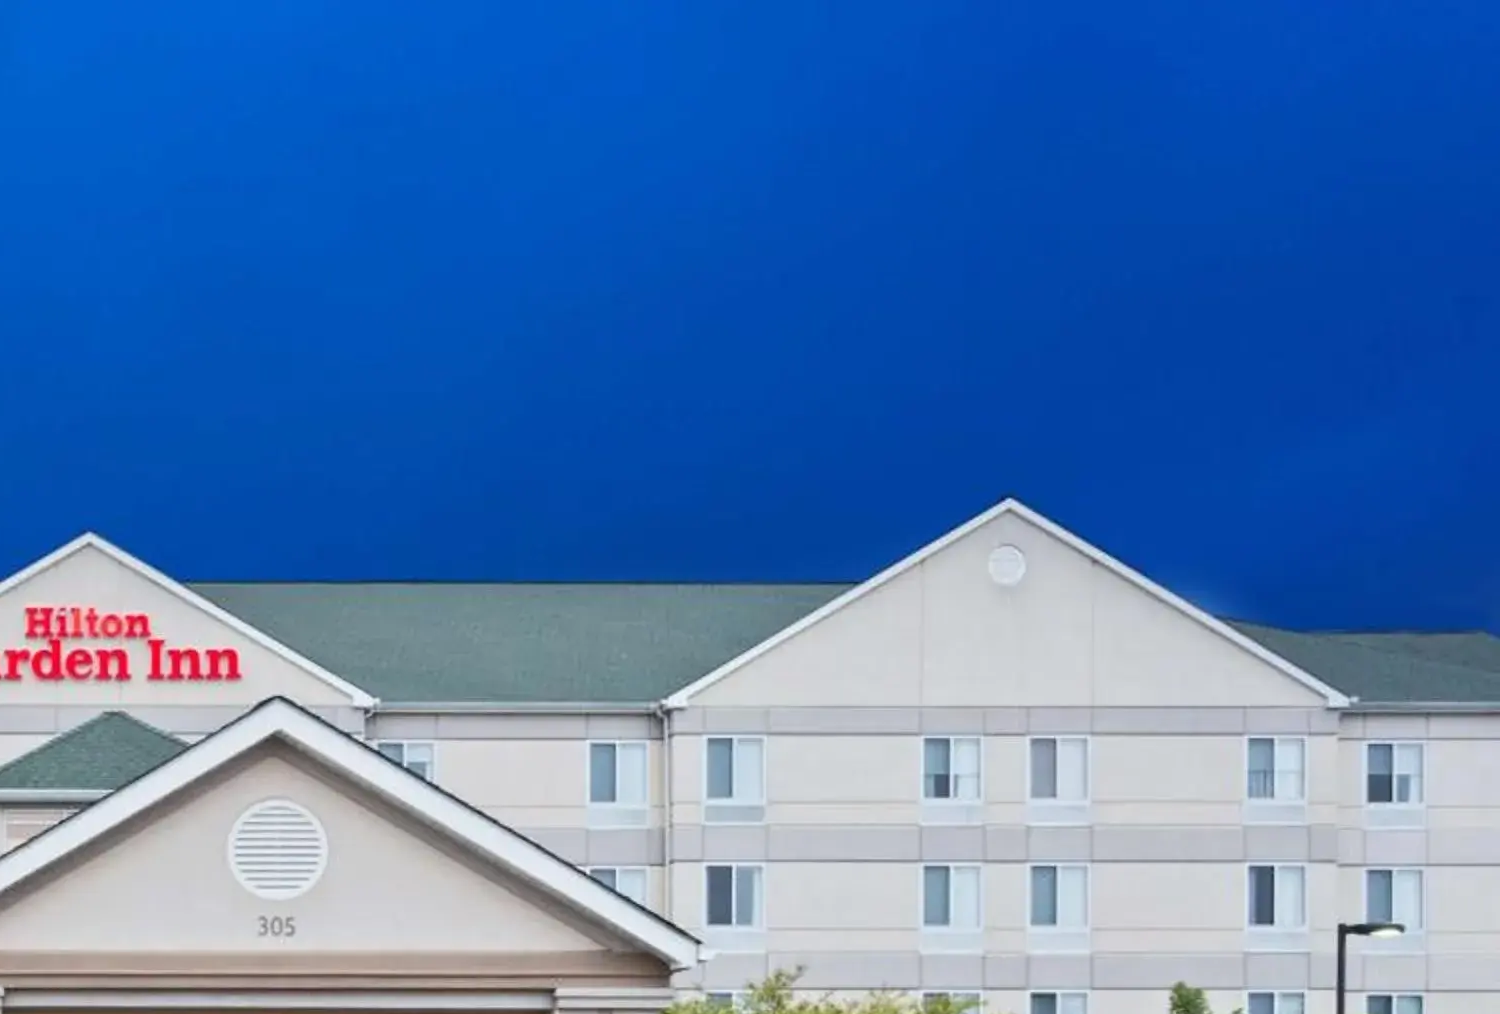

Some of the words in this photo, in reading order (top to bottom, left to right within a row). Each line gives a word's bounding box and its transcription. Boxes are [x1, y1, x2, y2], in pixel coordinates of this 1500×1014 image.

[24, 607, 151, 638] Hilton
[146, 639, 242, 682] Inn
[258, 915, 296, 937] 305
